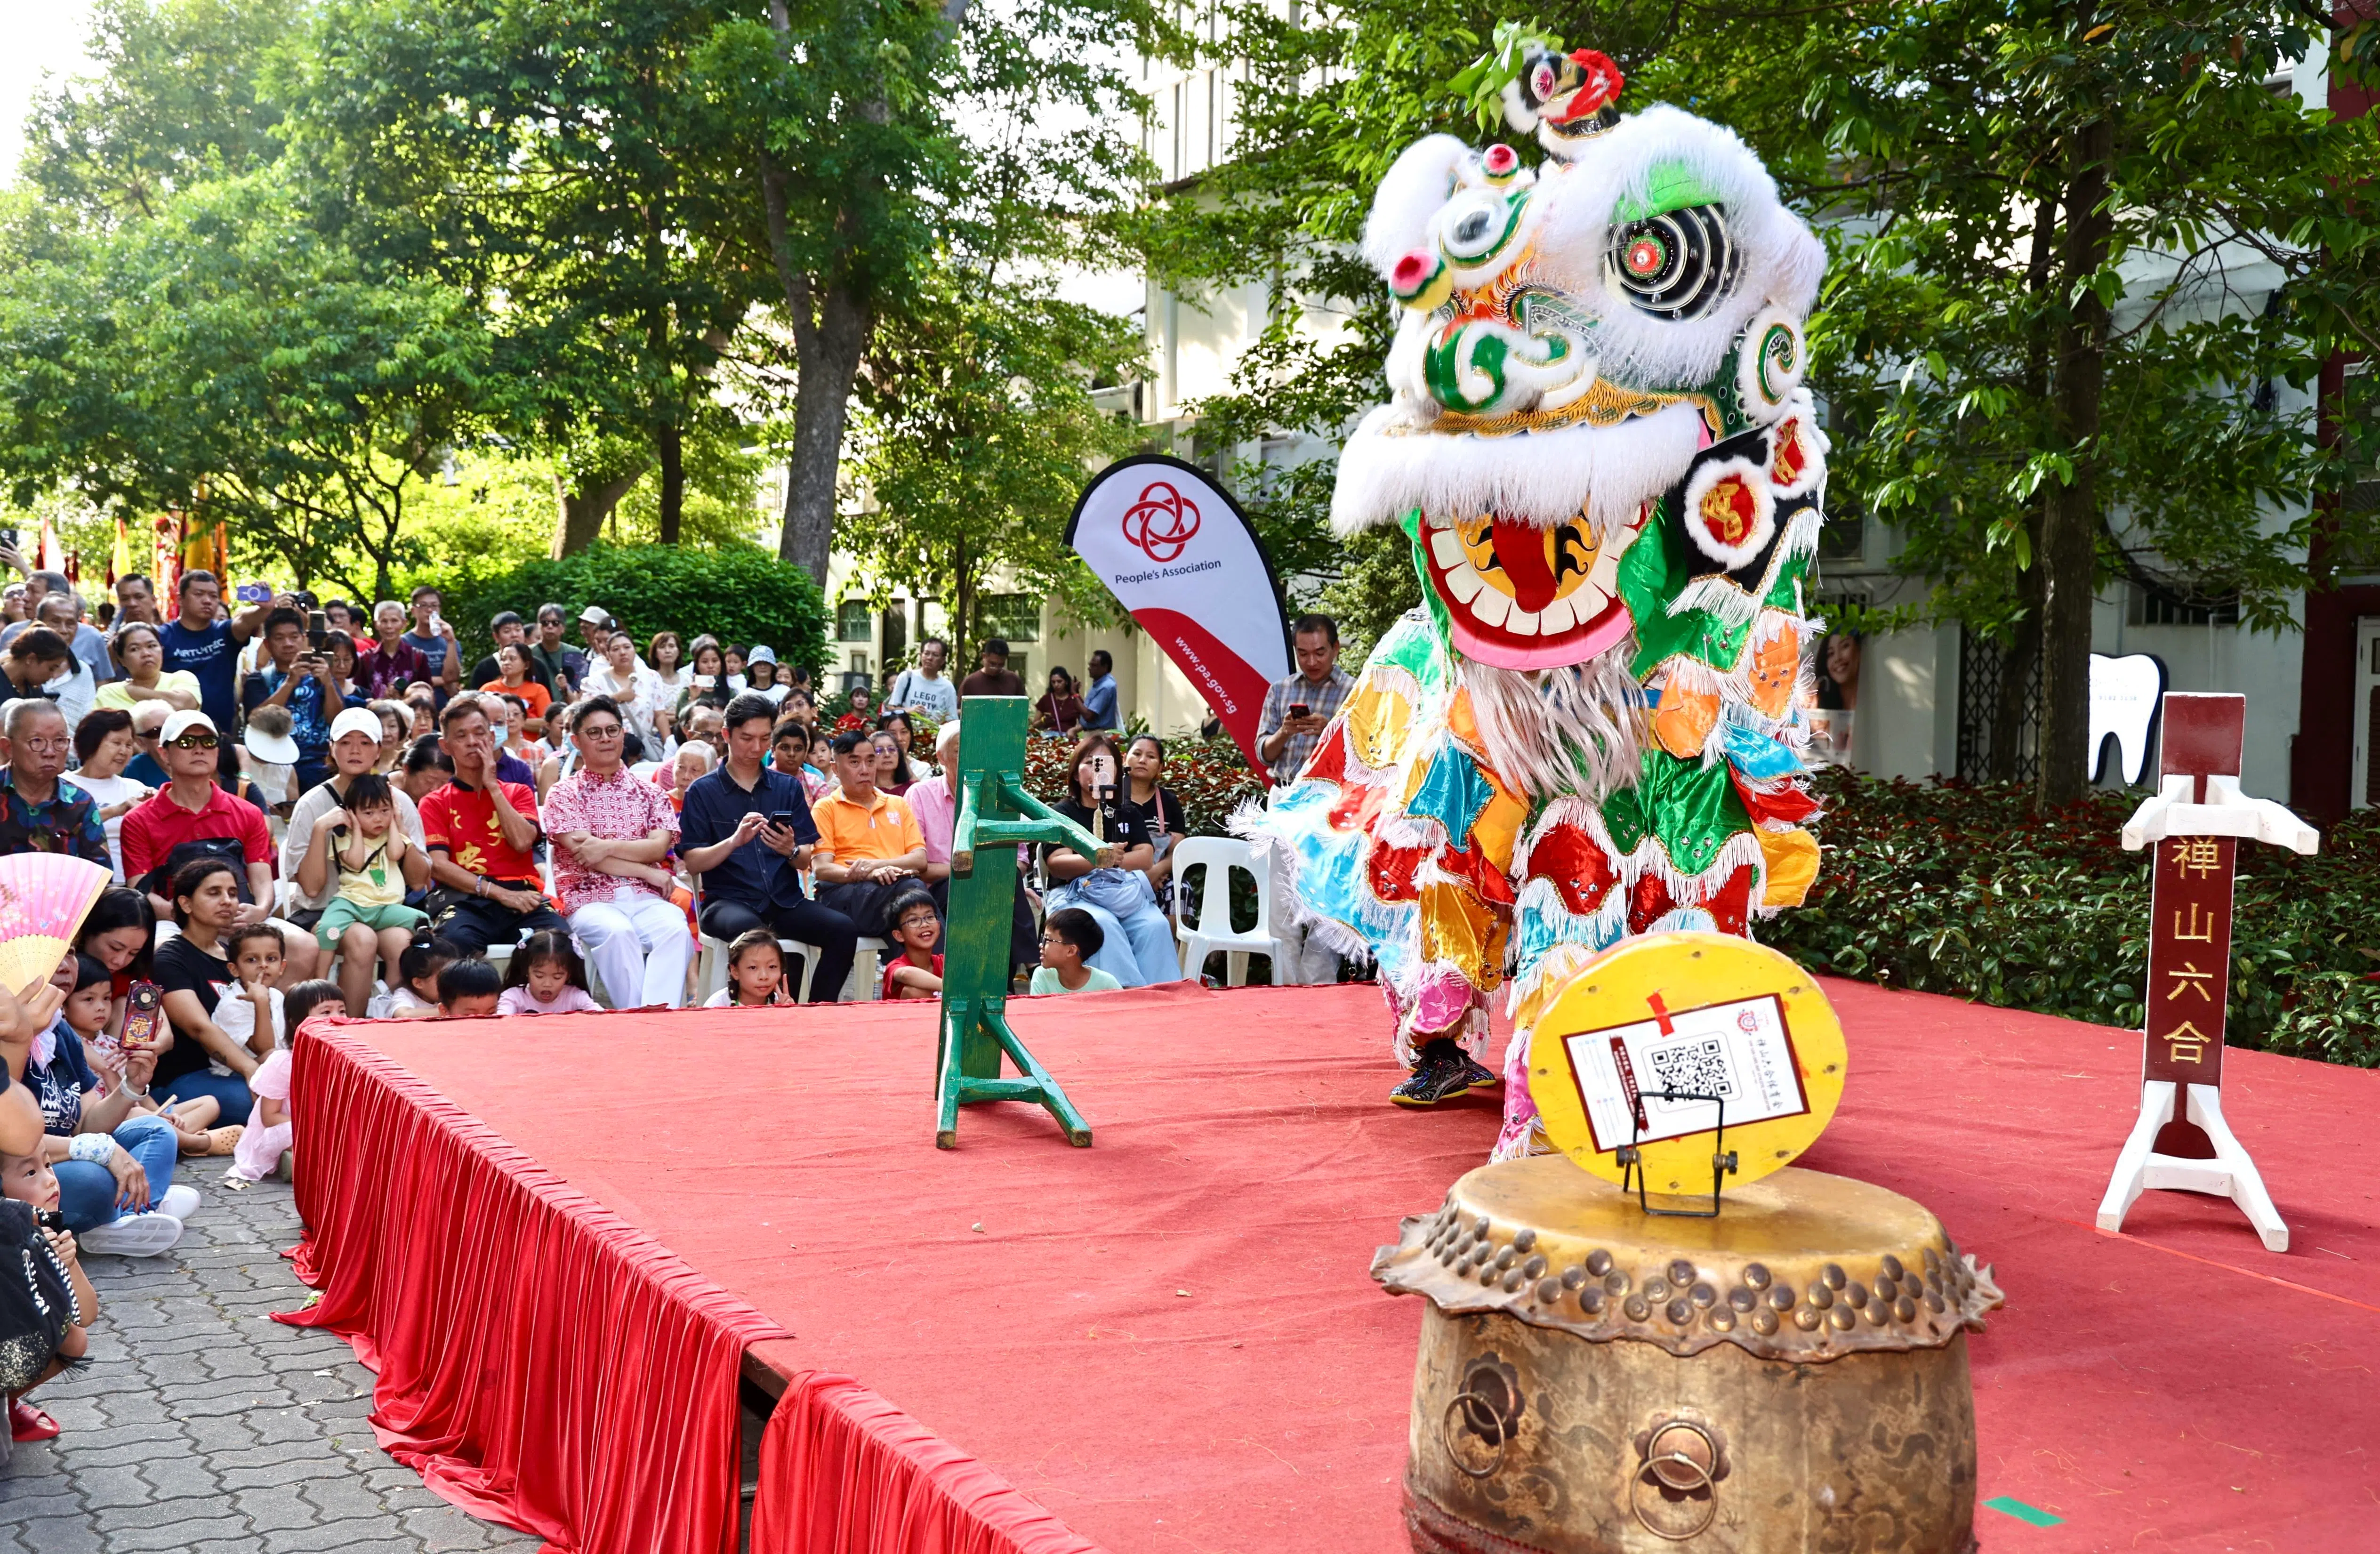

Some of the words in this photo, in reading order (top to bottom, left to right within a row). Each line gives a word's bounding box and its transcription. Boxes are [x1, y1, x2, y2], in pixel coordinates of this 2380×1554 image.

[1115, 570, 1159, 584] People's
[1162, 560, 1222, 578] Association
[914, 691, 936, 701] LEGO
[1175, 636, 1238, 714] www.pa.gov.sg
[2163, 835, 2221, 1064] 禅山六合
